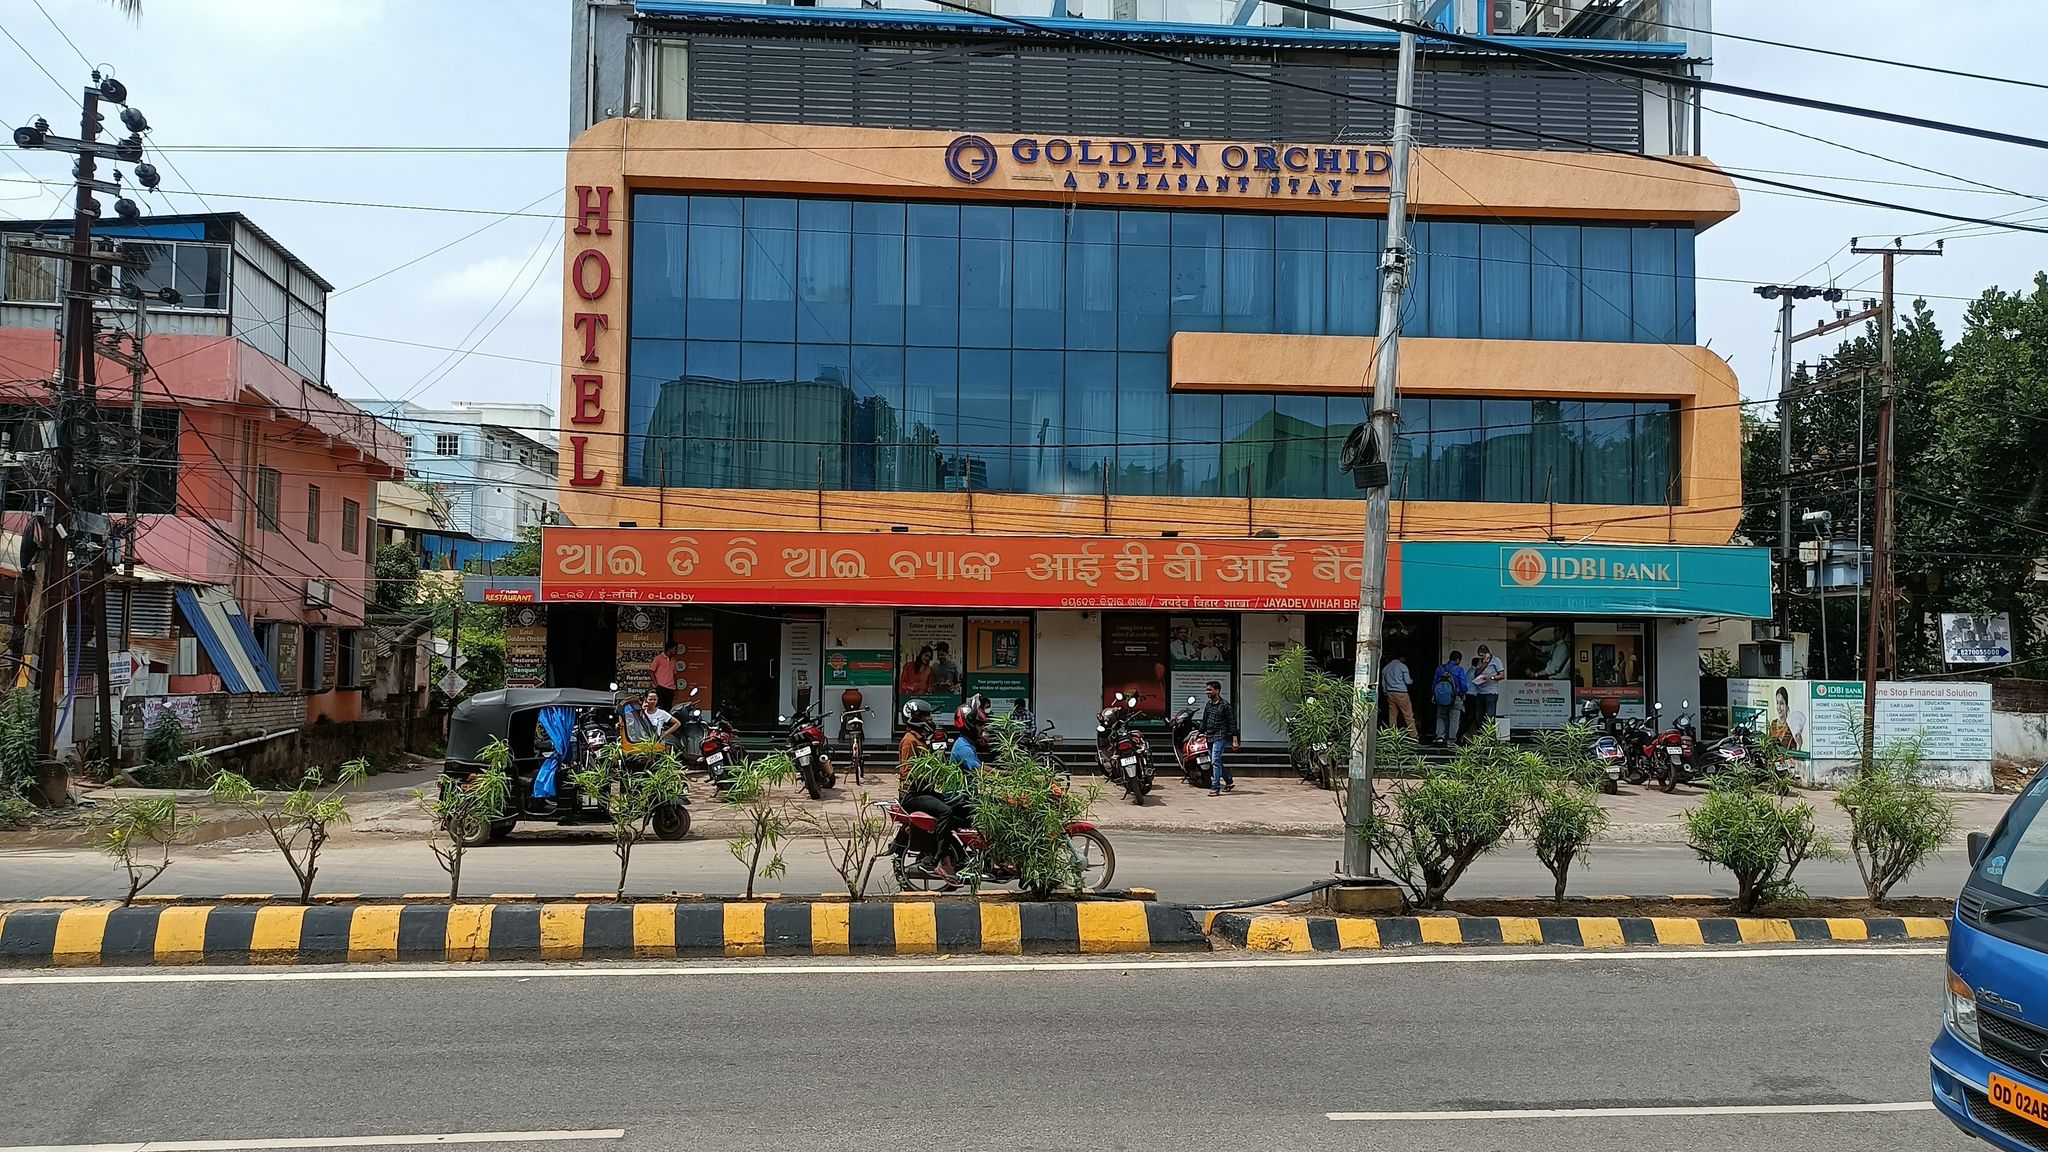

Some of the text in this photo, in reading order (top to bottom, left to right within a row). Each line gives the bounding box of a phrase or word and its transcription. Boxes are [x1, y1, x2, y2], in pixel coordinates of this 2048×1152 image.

[1012, 138, 1393, 175] GOLDEN ORCHID
[1064, 170, 1342, 196] A PLEASANT STAY
[569, 185, 614, 487] HOTEL
[1025, 542, 1104, 588] आई
[1113, 542, 1155, 582] डी
[1162, 542, 1208, 583] बी
[1216, 544, 1295, 588] आई
[1551, 556, 1672, 582] IDBI BANK
[486, 594, 532, 602] RESTAURANT
[648, 592, 696, 601] e-Lobby
[1263, 598, 1308, 608] JAYADEV
[1310, 598, 1341, 609] VIHAR
[1890, 688, 1908, 697] Stop
[1910, 688, 1944, 696] Financial
[1946, 689, 1978, 697] Solution
[1993, 1083, 2048, 1122] OD 02AB
